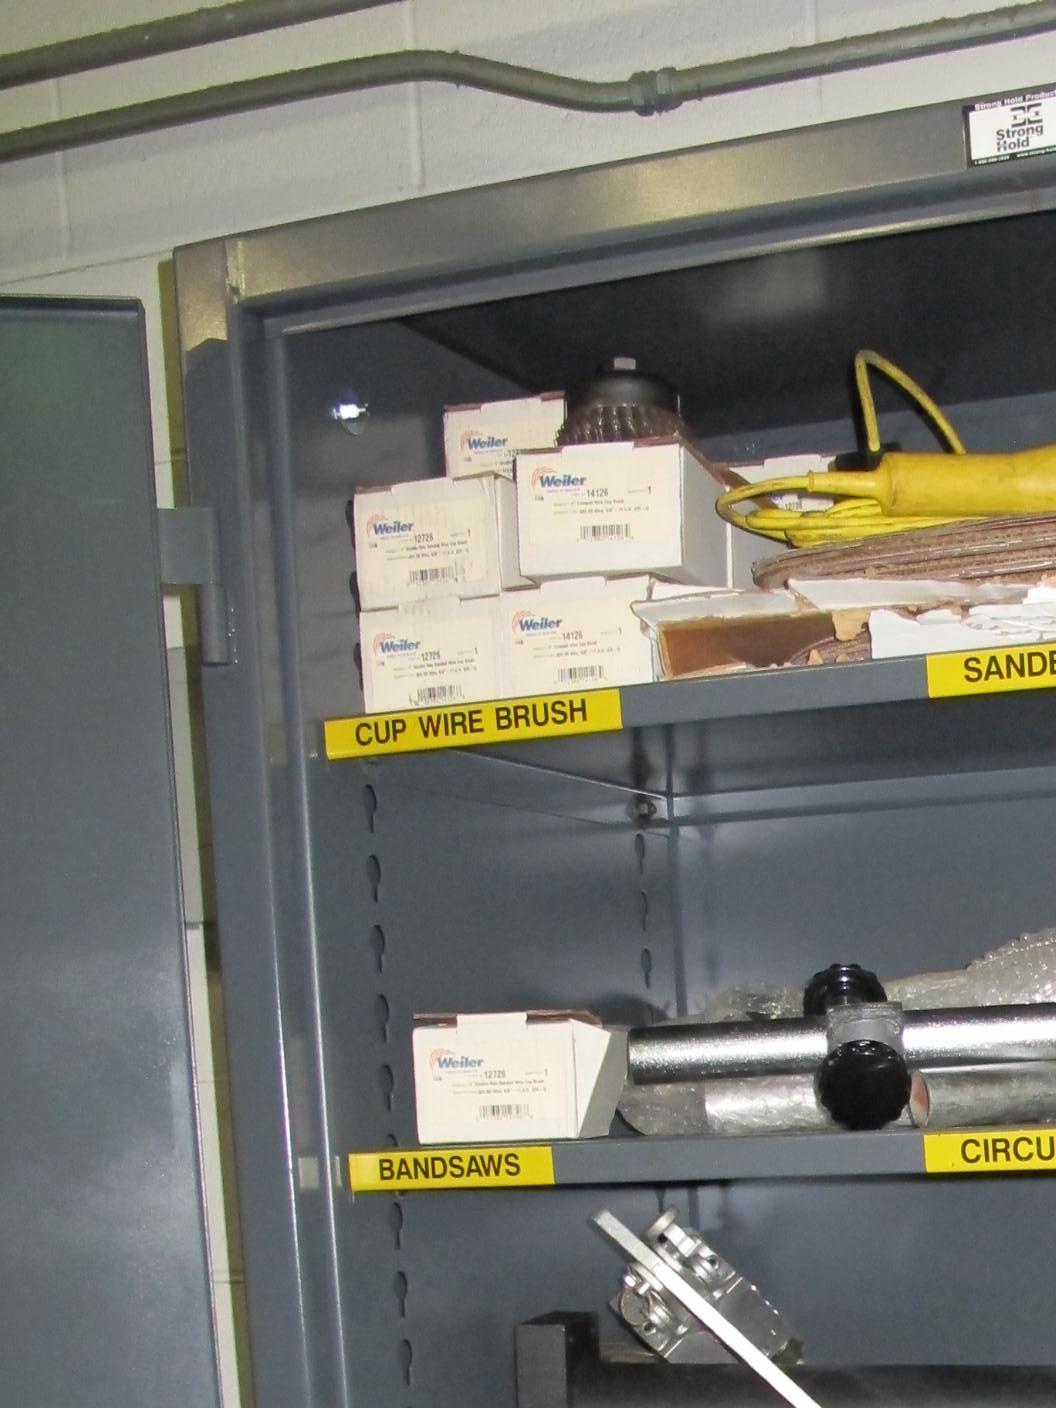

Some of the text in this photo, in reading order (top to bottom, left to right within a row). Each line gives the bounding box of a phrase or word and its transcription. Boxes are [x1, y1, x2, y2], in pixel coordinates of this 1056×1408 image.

[974, 101, 1002, 111] Strong
[1004, 97, 1023, 106] Hold
[996, 124, 1044, 141] Strong
[997, 137, 1030, 152] Hold
[468, 436, 508, 449] Weiler
[538, 474, 587, 488] Weiler
[587, 488, 608, 498] 14126
[373, 520, 414, 535] Weiler
[520, 617, 562, 632] Weiler
[380, 639, 421, 653] Weiler
[355, 698, 588, 746] CUP WIRE BRUSH
[437, 1056, 484, 1068] Weiler
[379, 1153, 521, 1181] BANDSAWS
